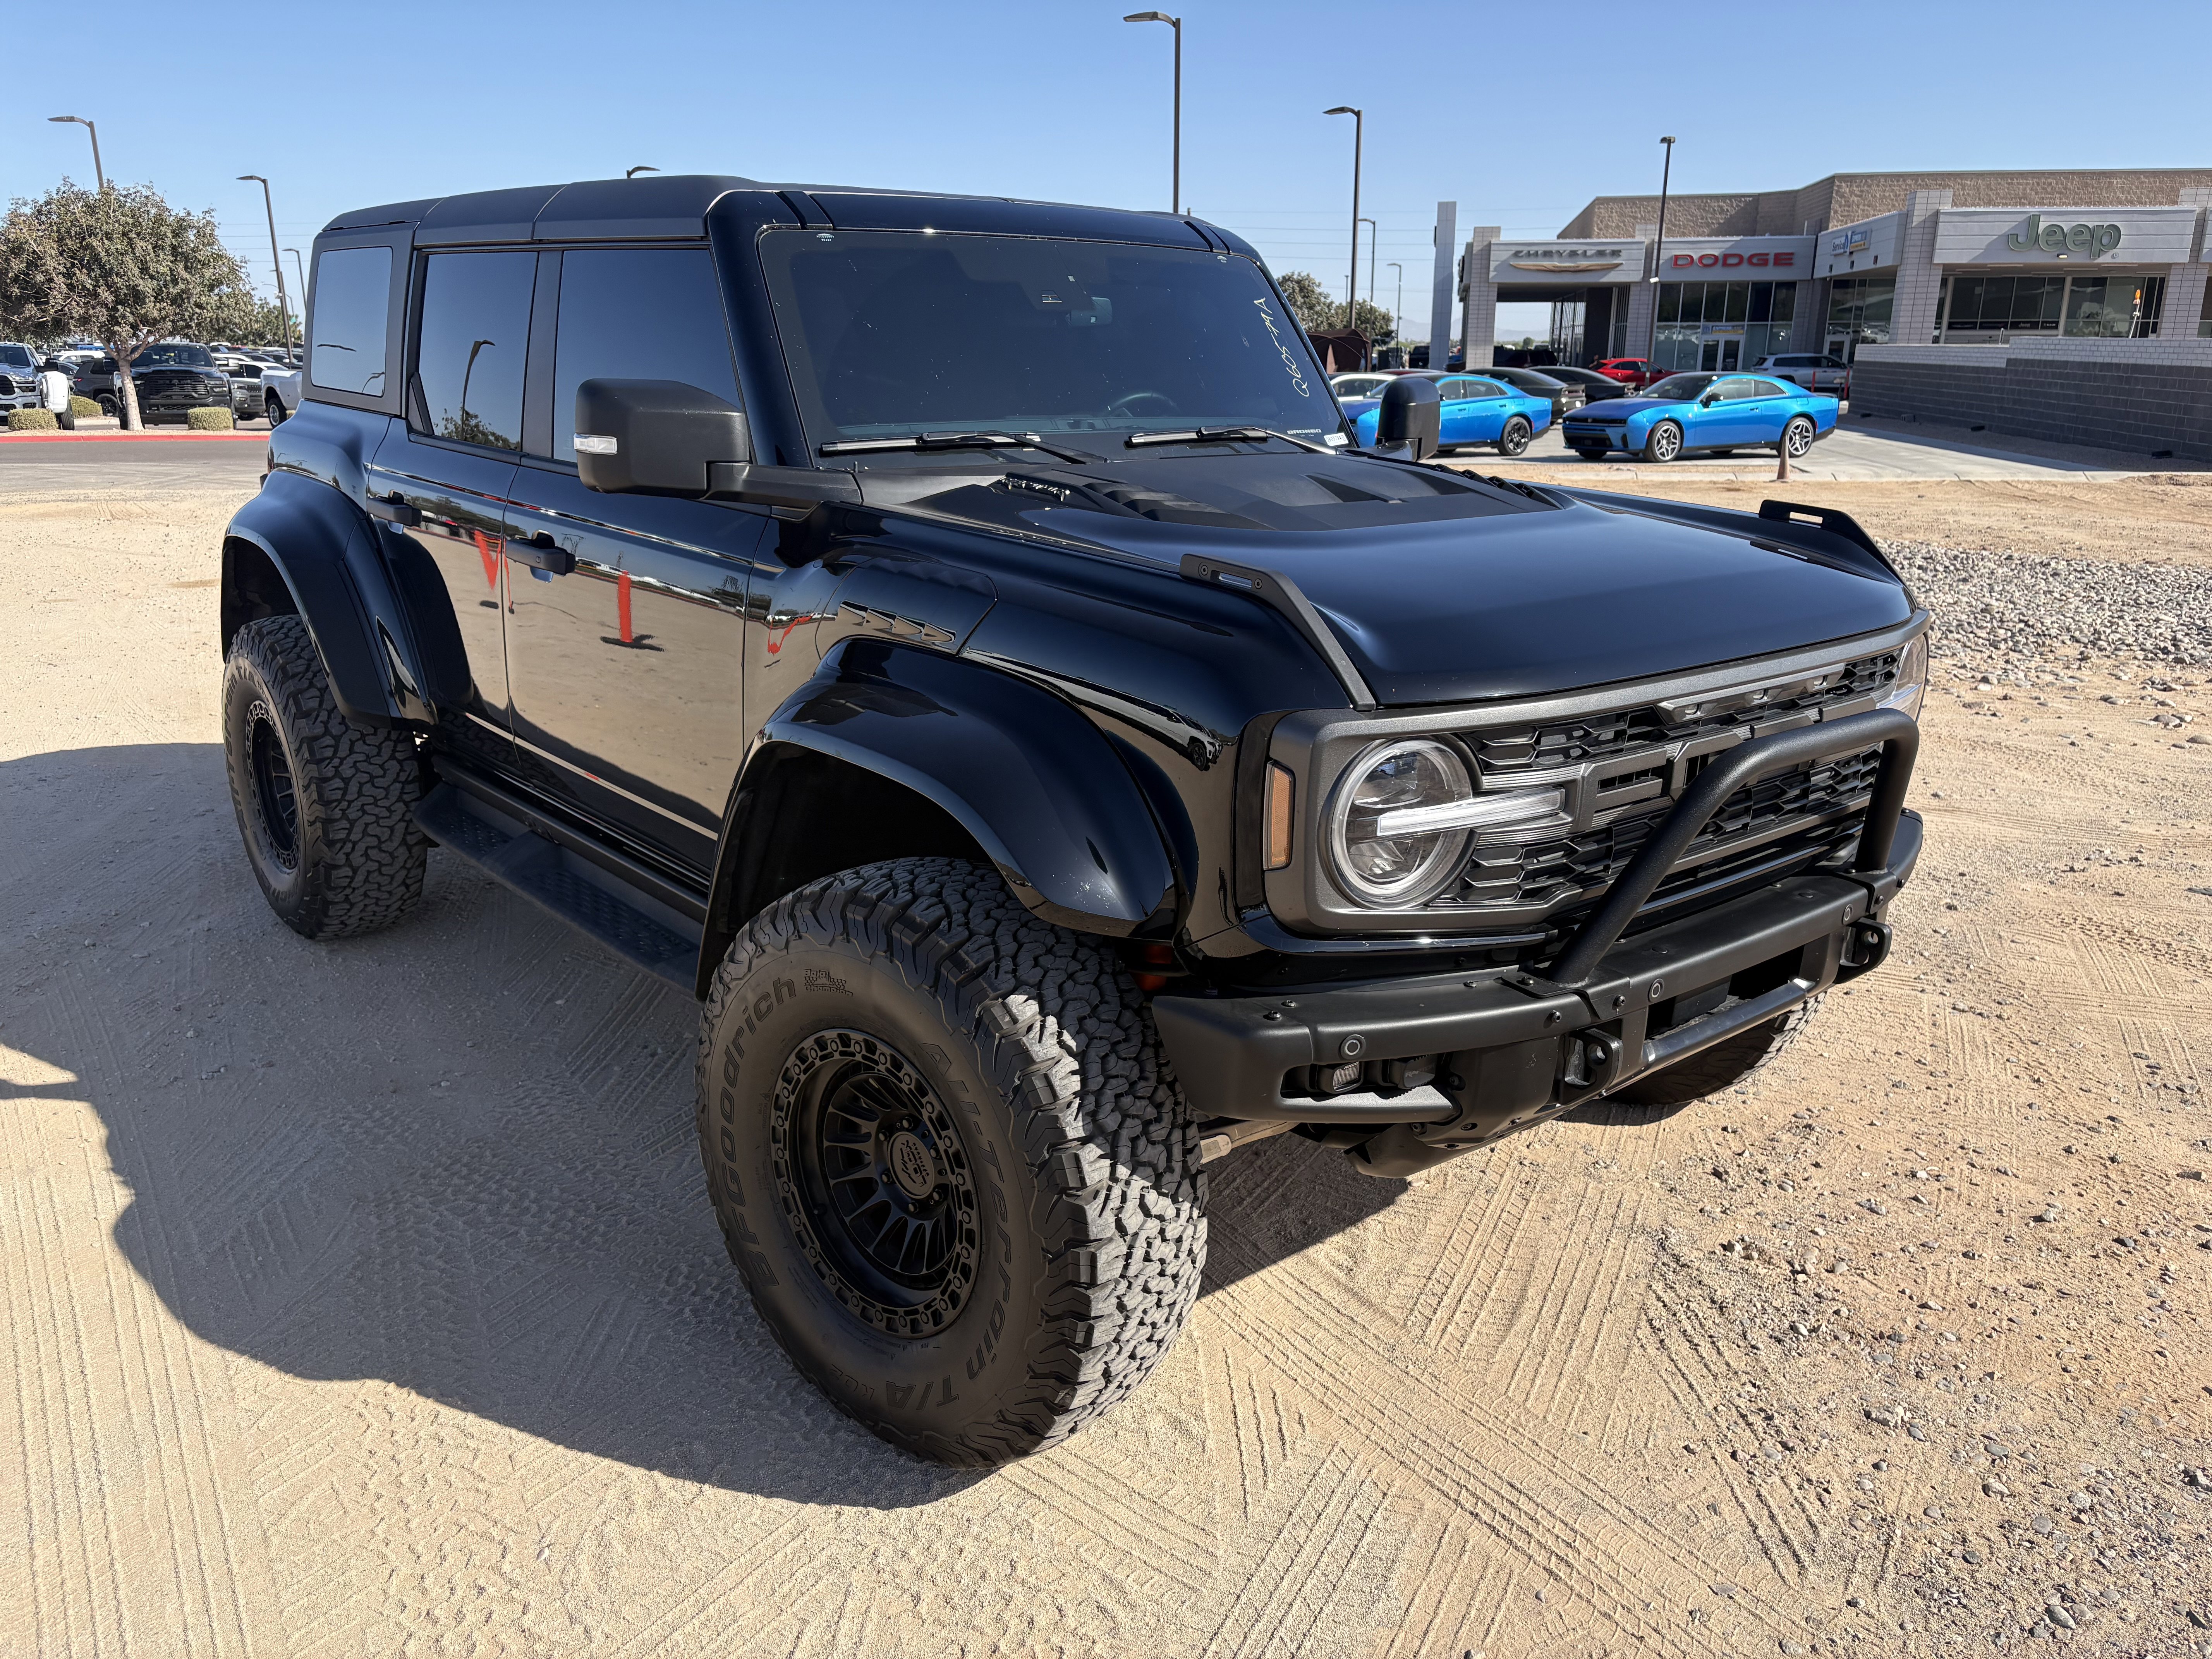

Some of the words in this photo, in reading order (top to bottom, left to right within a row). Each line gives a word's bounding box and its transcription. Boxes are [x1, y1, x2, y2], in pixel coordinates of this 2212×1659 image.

[1513, 249, 1622, 258] CHRYSLER
[2008, 214, 2122, 259] Jeep
[1672, 252, 1795, 268] DODGE
[720, 977, 796, 1286] BFGoodrich
[917, 1042, 1012, 1381] All-Terrain
[886, 1374, 960, 1410] T/A
